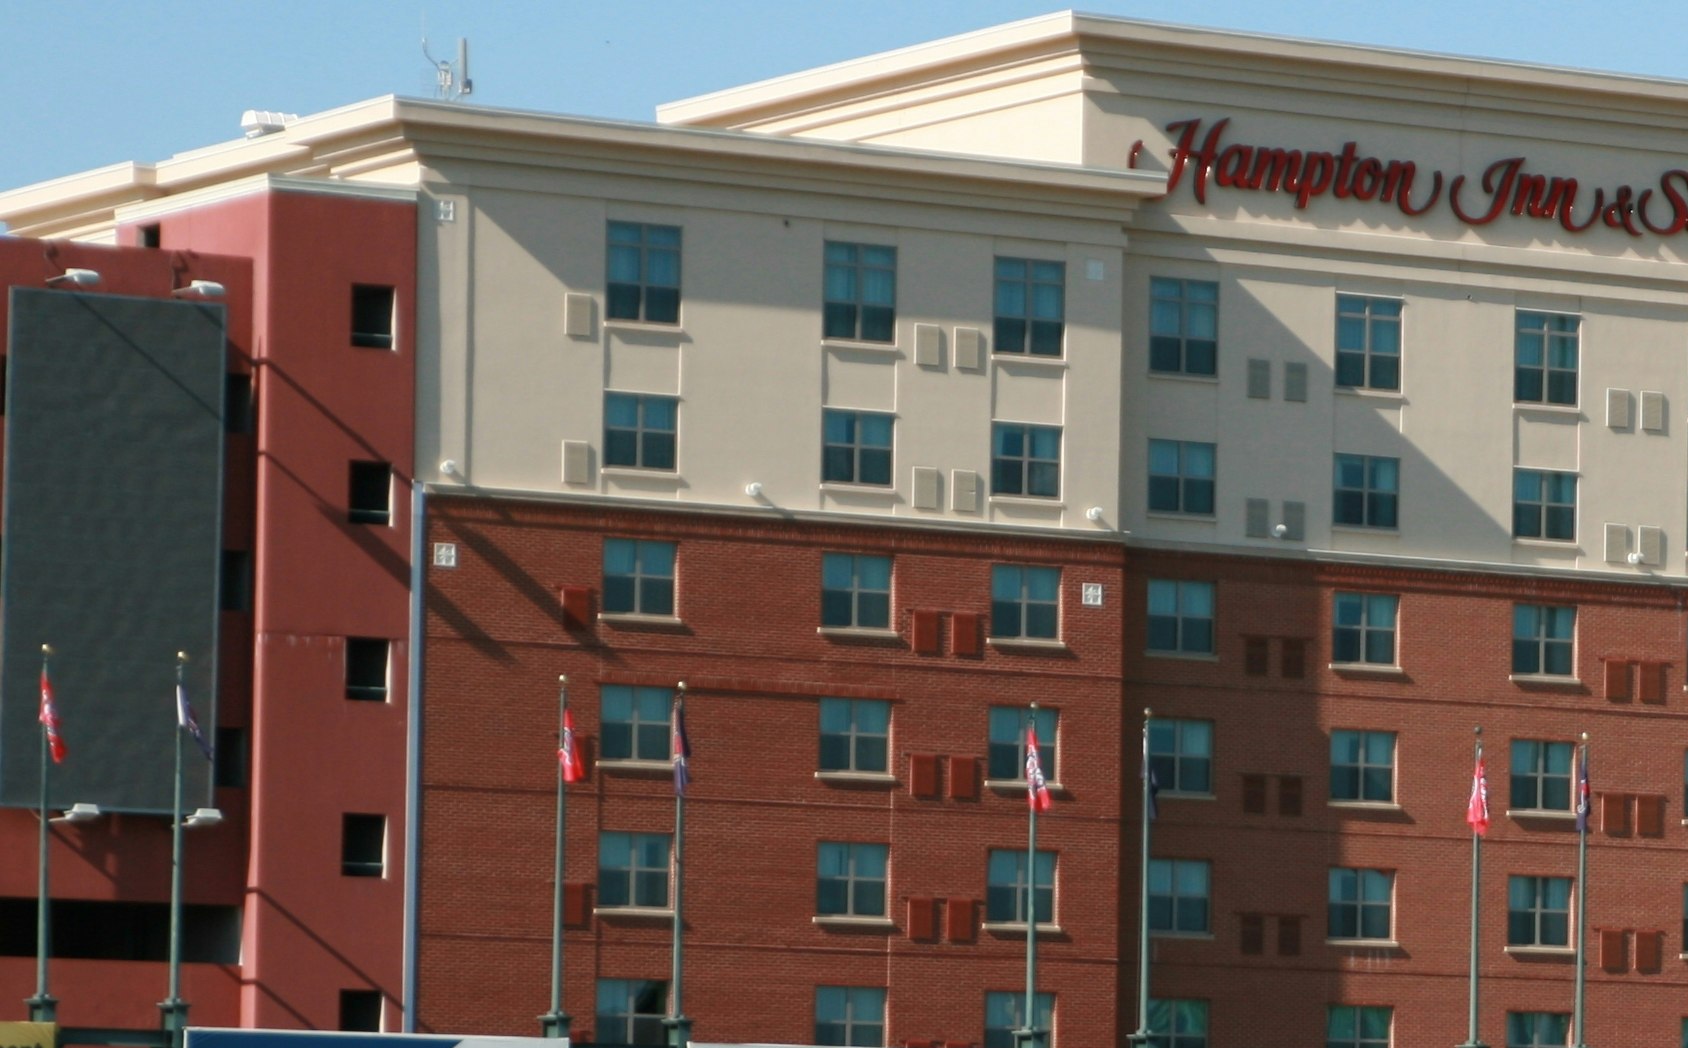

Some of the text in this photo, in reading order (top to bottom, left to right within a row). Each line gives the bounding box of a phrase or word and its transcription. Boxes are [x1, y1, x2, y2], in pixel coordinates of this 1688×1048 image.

[1129, 117, 1442, 217] Hampton
[1450, 157, 1604, 233] Inn
[1604, 182, 1644, 238] &
